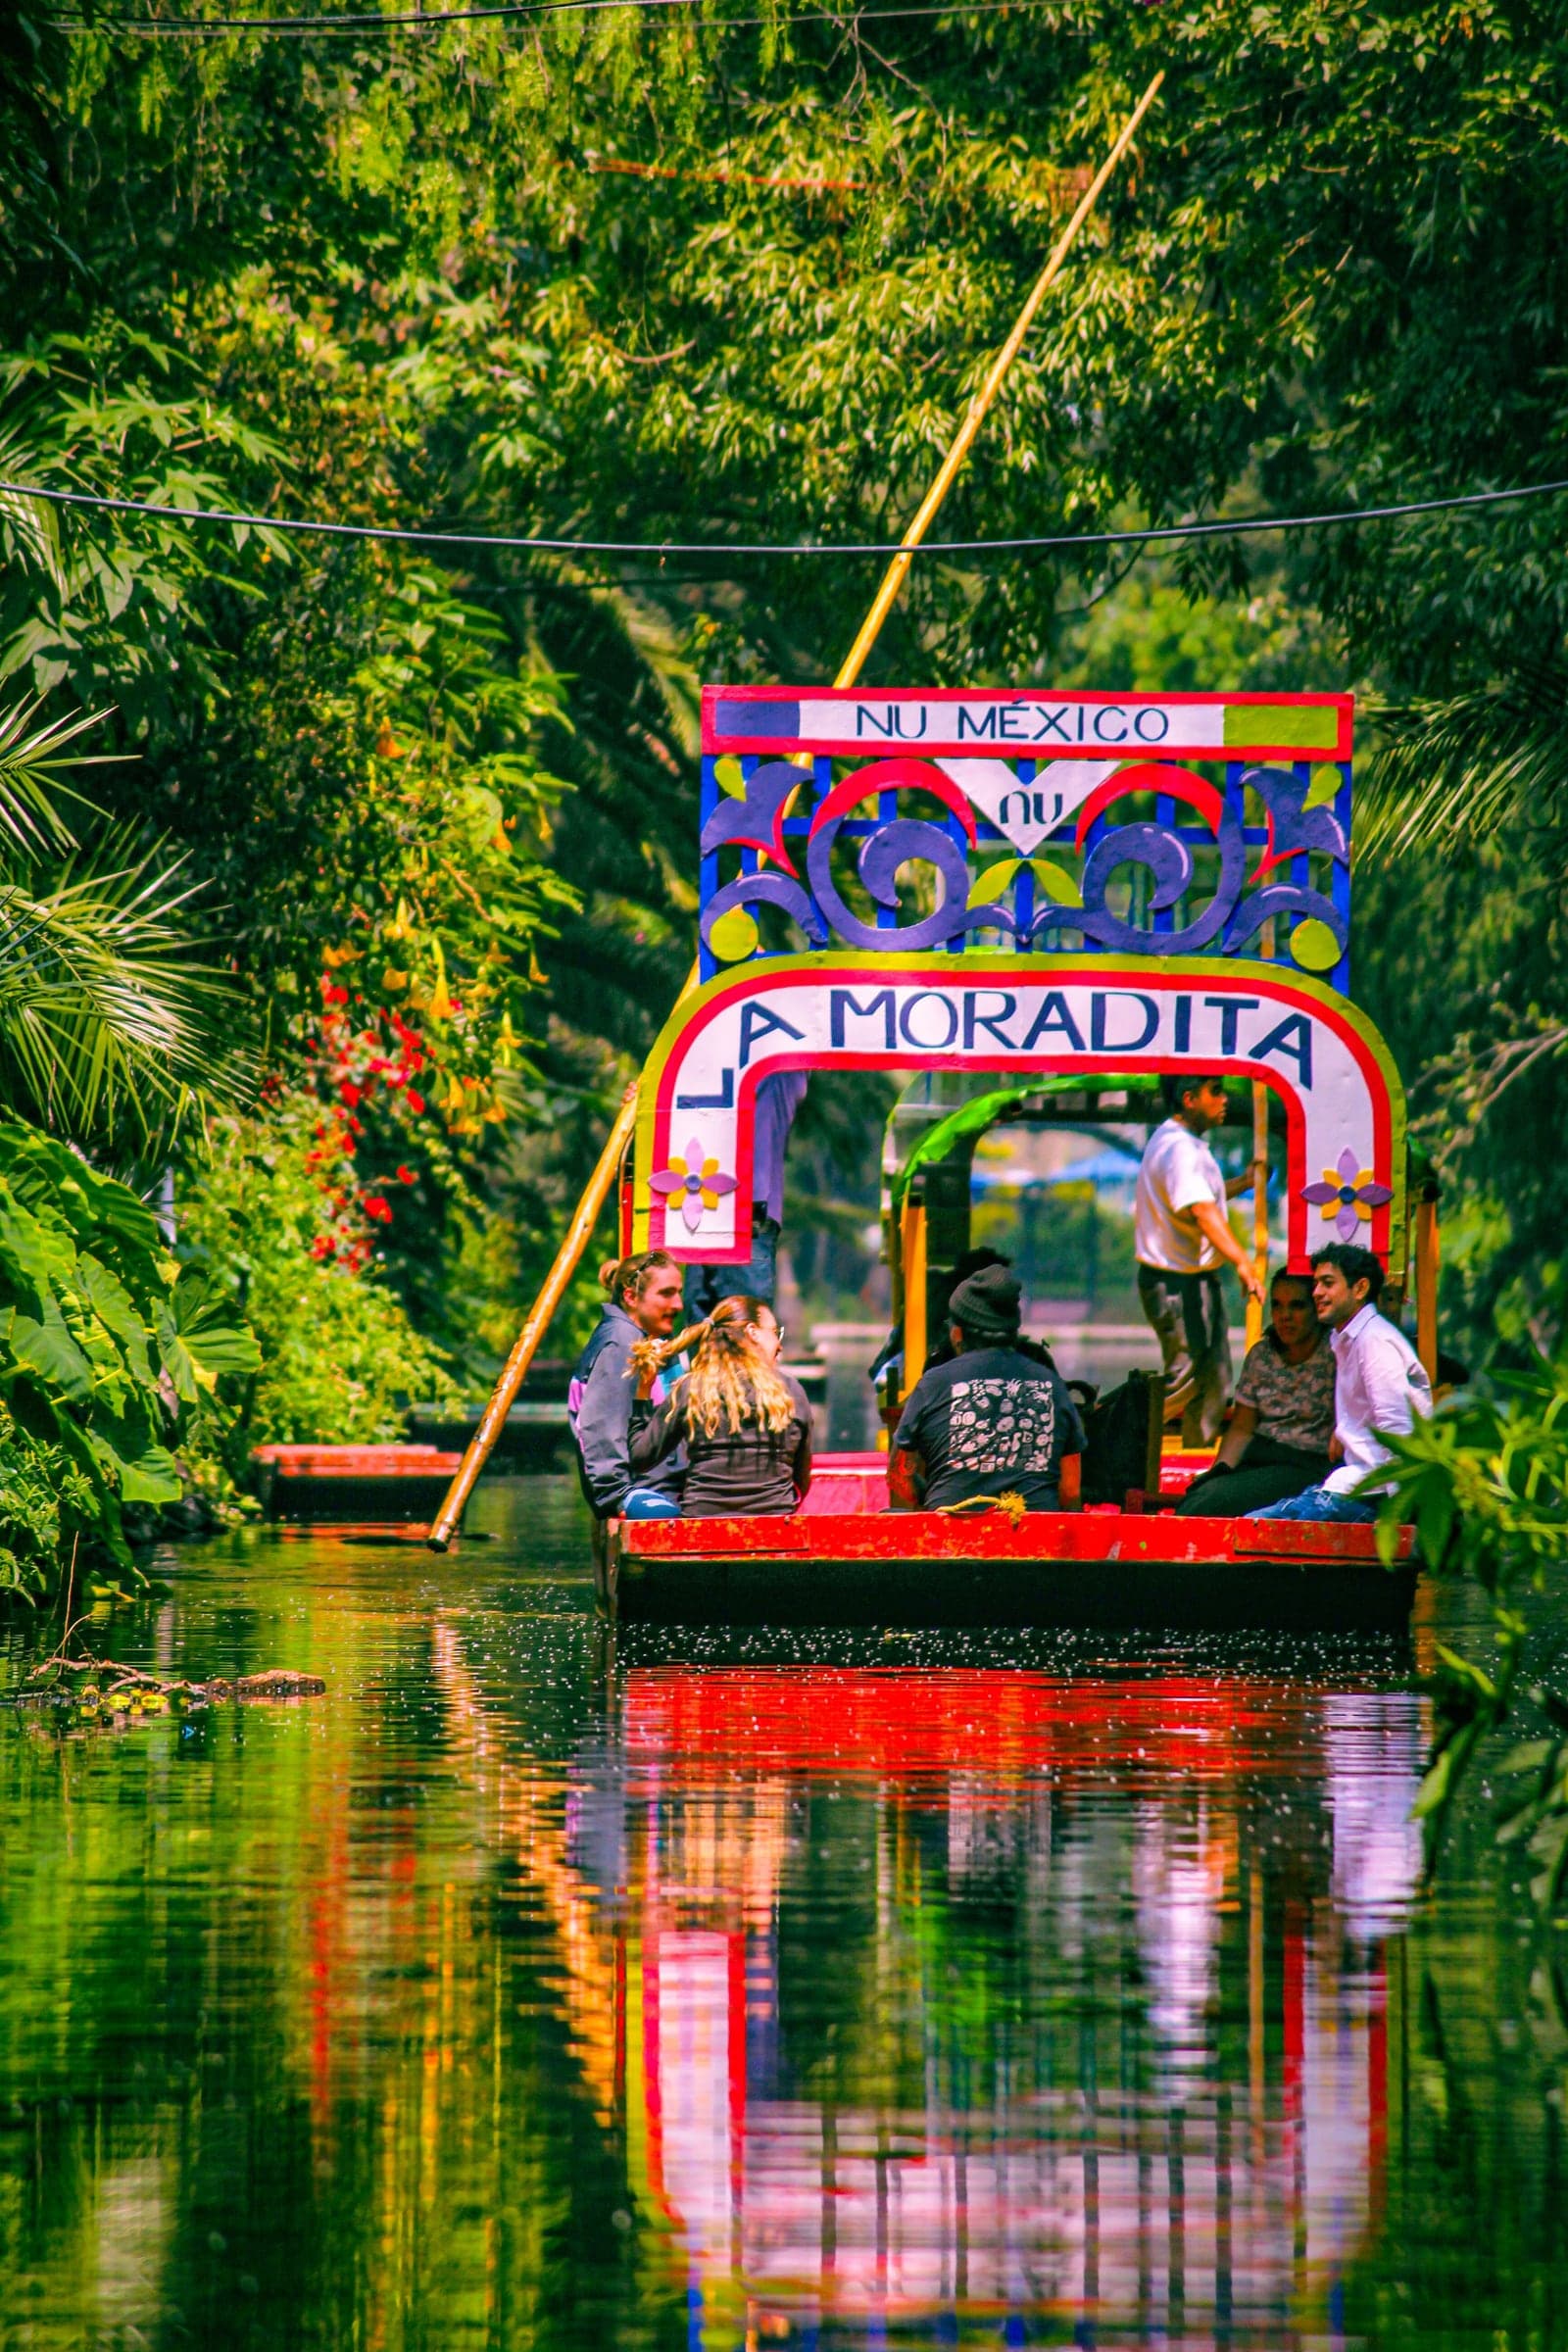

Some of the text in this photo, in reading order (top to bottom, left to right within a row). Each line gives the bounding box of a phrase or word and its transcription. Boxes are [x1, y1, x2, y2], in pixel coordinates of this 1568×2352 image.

[856, 698, 1169, 742] NU MÉXICO
[676, 989, 1312, 1109] LA MORADITA
